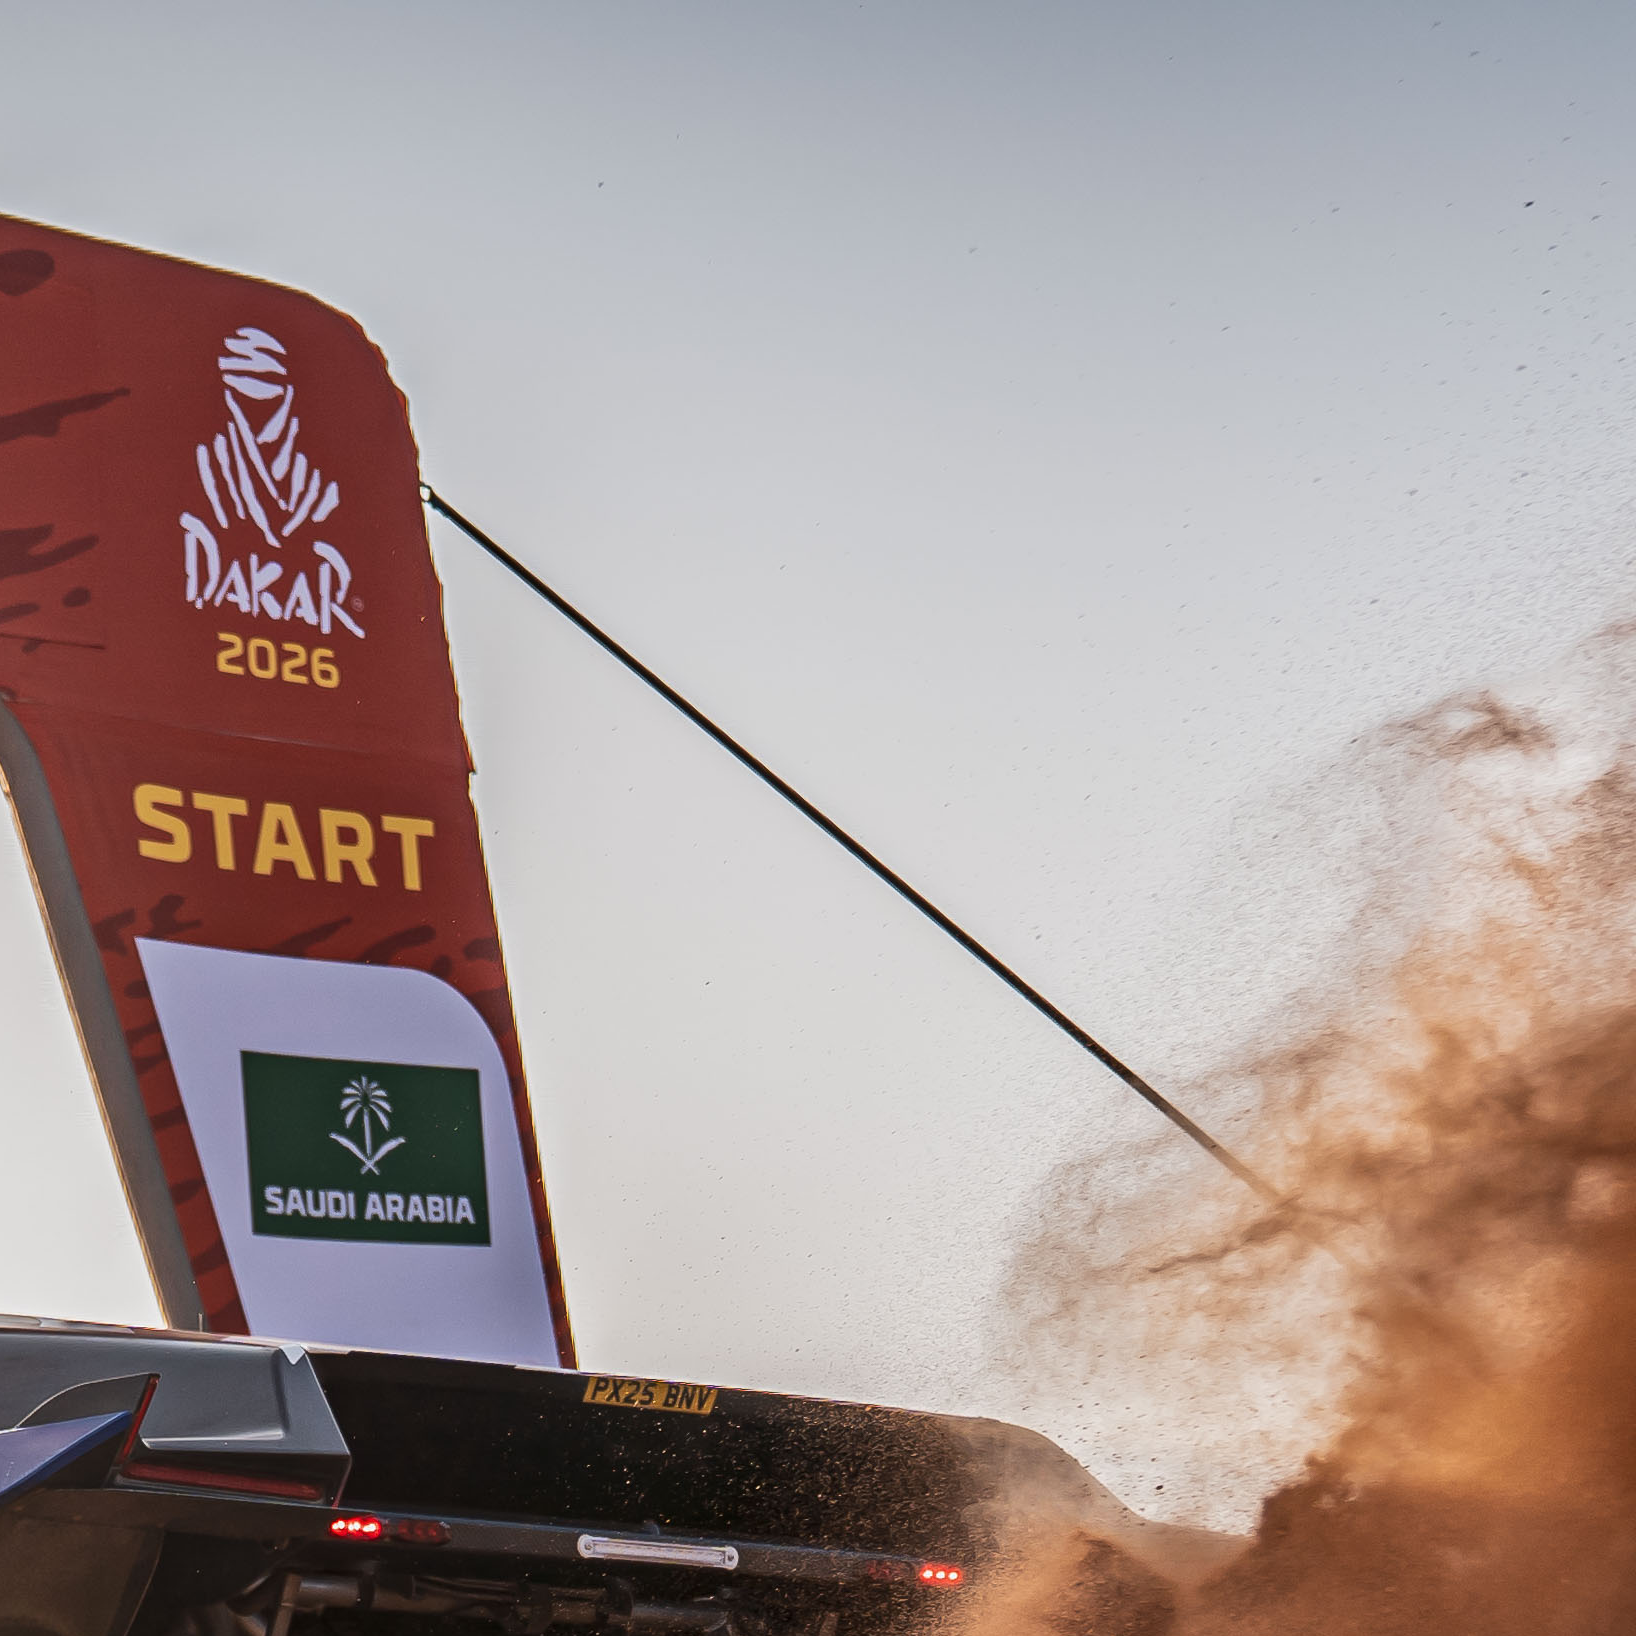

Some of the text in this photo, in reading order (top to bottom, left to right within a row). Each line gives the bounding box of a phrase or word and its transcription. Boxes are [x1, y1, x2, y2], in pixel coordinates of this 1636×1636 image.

[179, 511, 365, 639] DAKAR
[216, 631, 340, 689] 2026
[133, 783, 435, 892] START
[264, 1184, 476, 1225] SAUDI ARABIA
[591, 1376, 714, 1411] PX25 BNV
